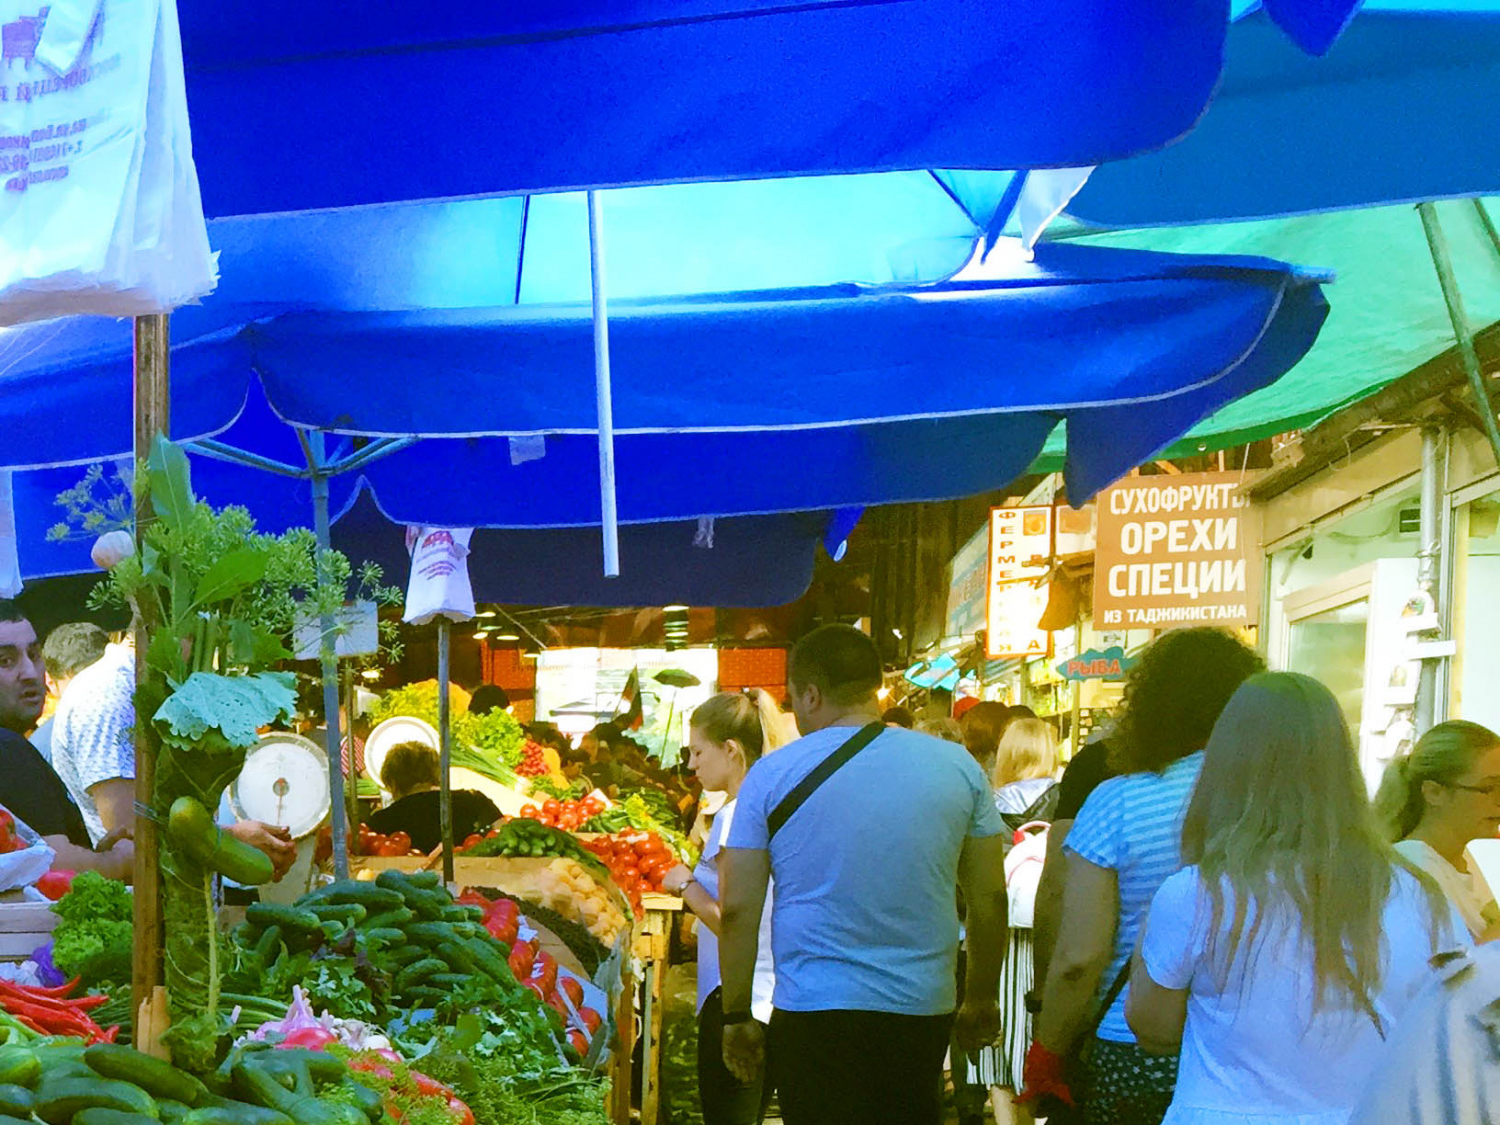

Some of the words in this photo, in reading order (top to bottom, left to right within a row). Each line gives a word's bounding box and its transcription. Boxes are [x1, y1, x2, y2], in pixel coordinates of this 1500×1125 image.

[1120, 517, 1237, 555] ОРЕХИ
[1108, 558, 1246, 599] СПЕЦИИ
[1103, 609, 1122, 624] ИЗ
[1127, 603, 1247, 624] ТАДЖИКИСТАНА
[1067, 658, 1121, 676] РЫБА
